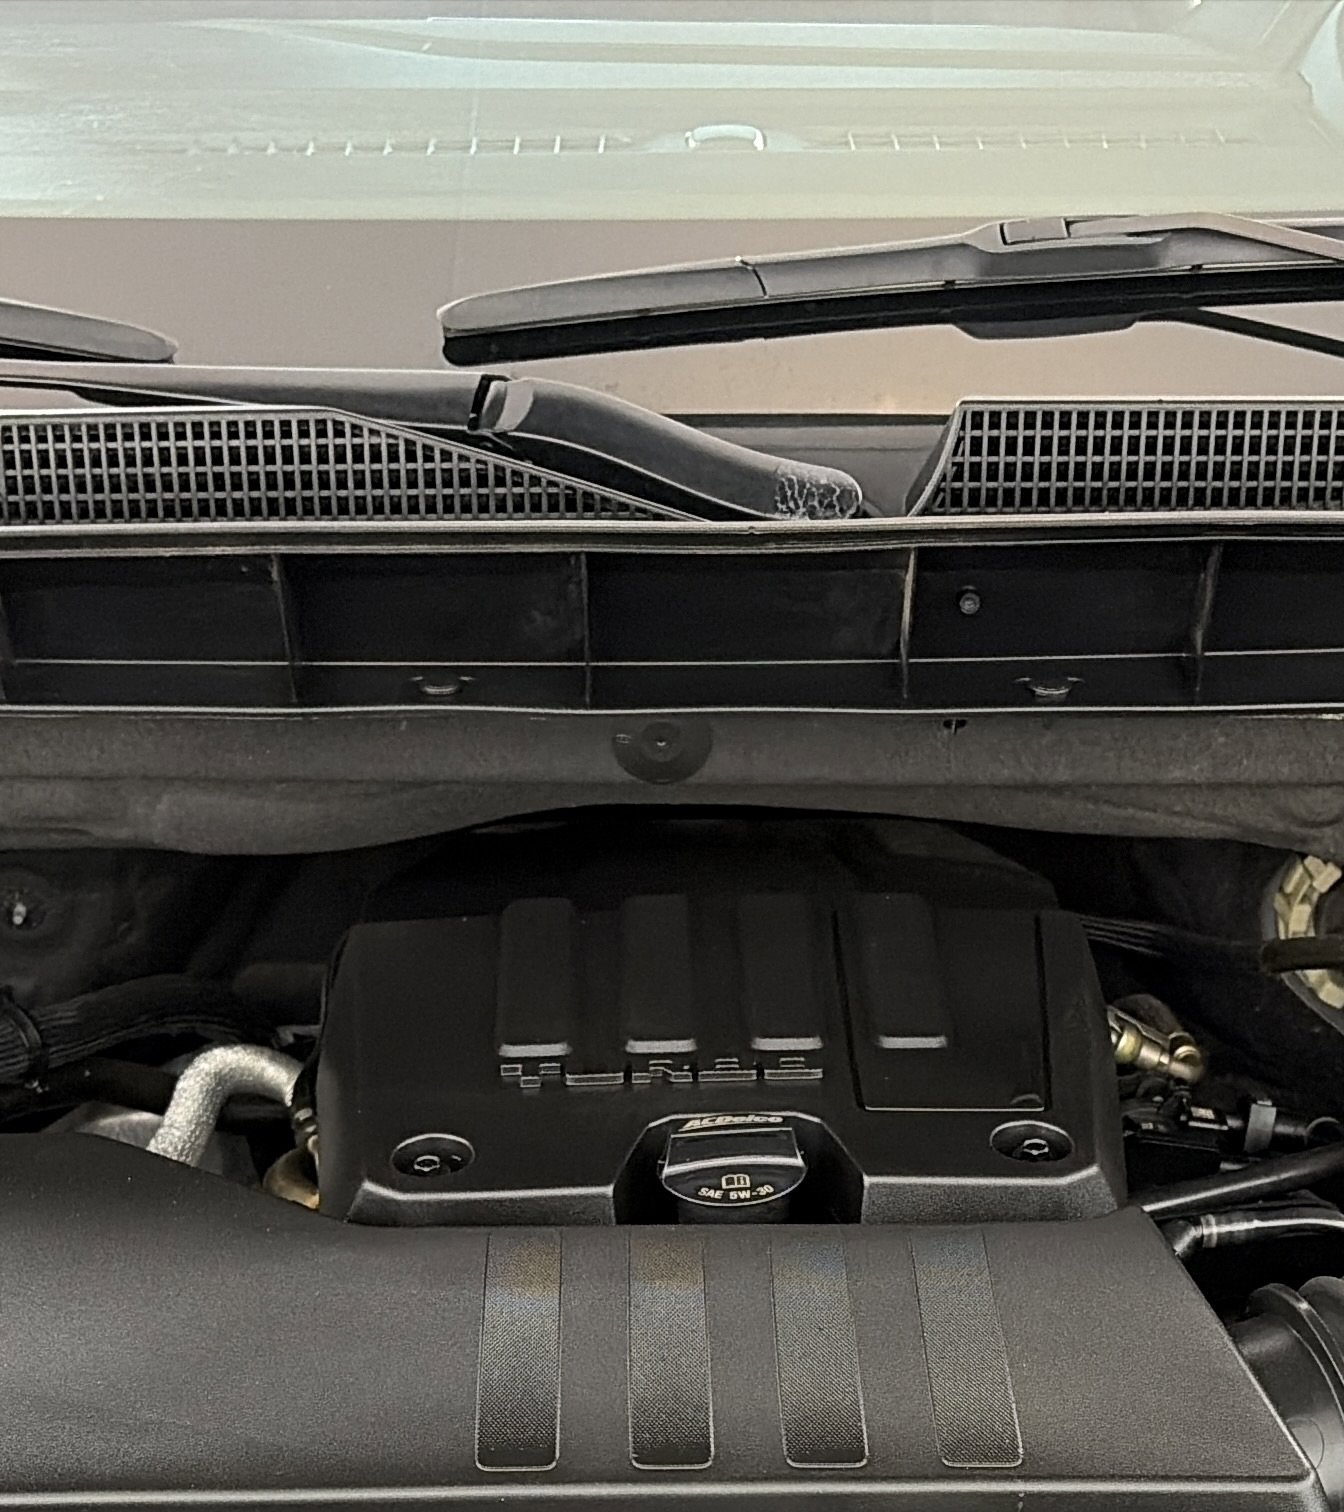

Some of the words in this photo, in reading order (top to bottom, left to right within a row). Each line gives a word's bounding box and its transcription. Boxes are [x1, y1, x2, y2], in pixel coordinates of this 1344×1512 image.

[680, 1115, 784, 1131] ACDelco
[698, 1187, 724, 1200] SAE
[729, 1185, 774, 1200] 5W-30
